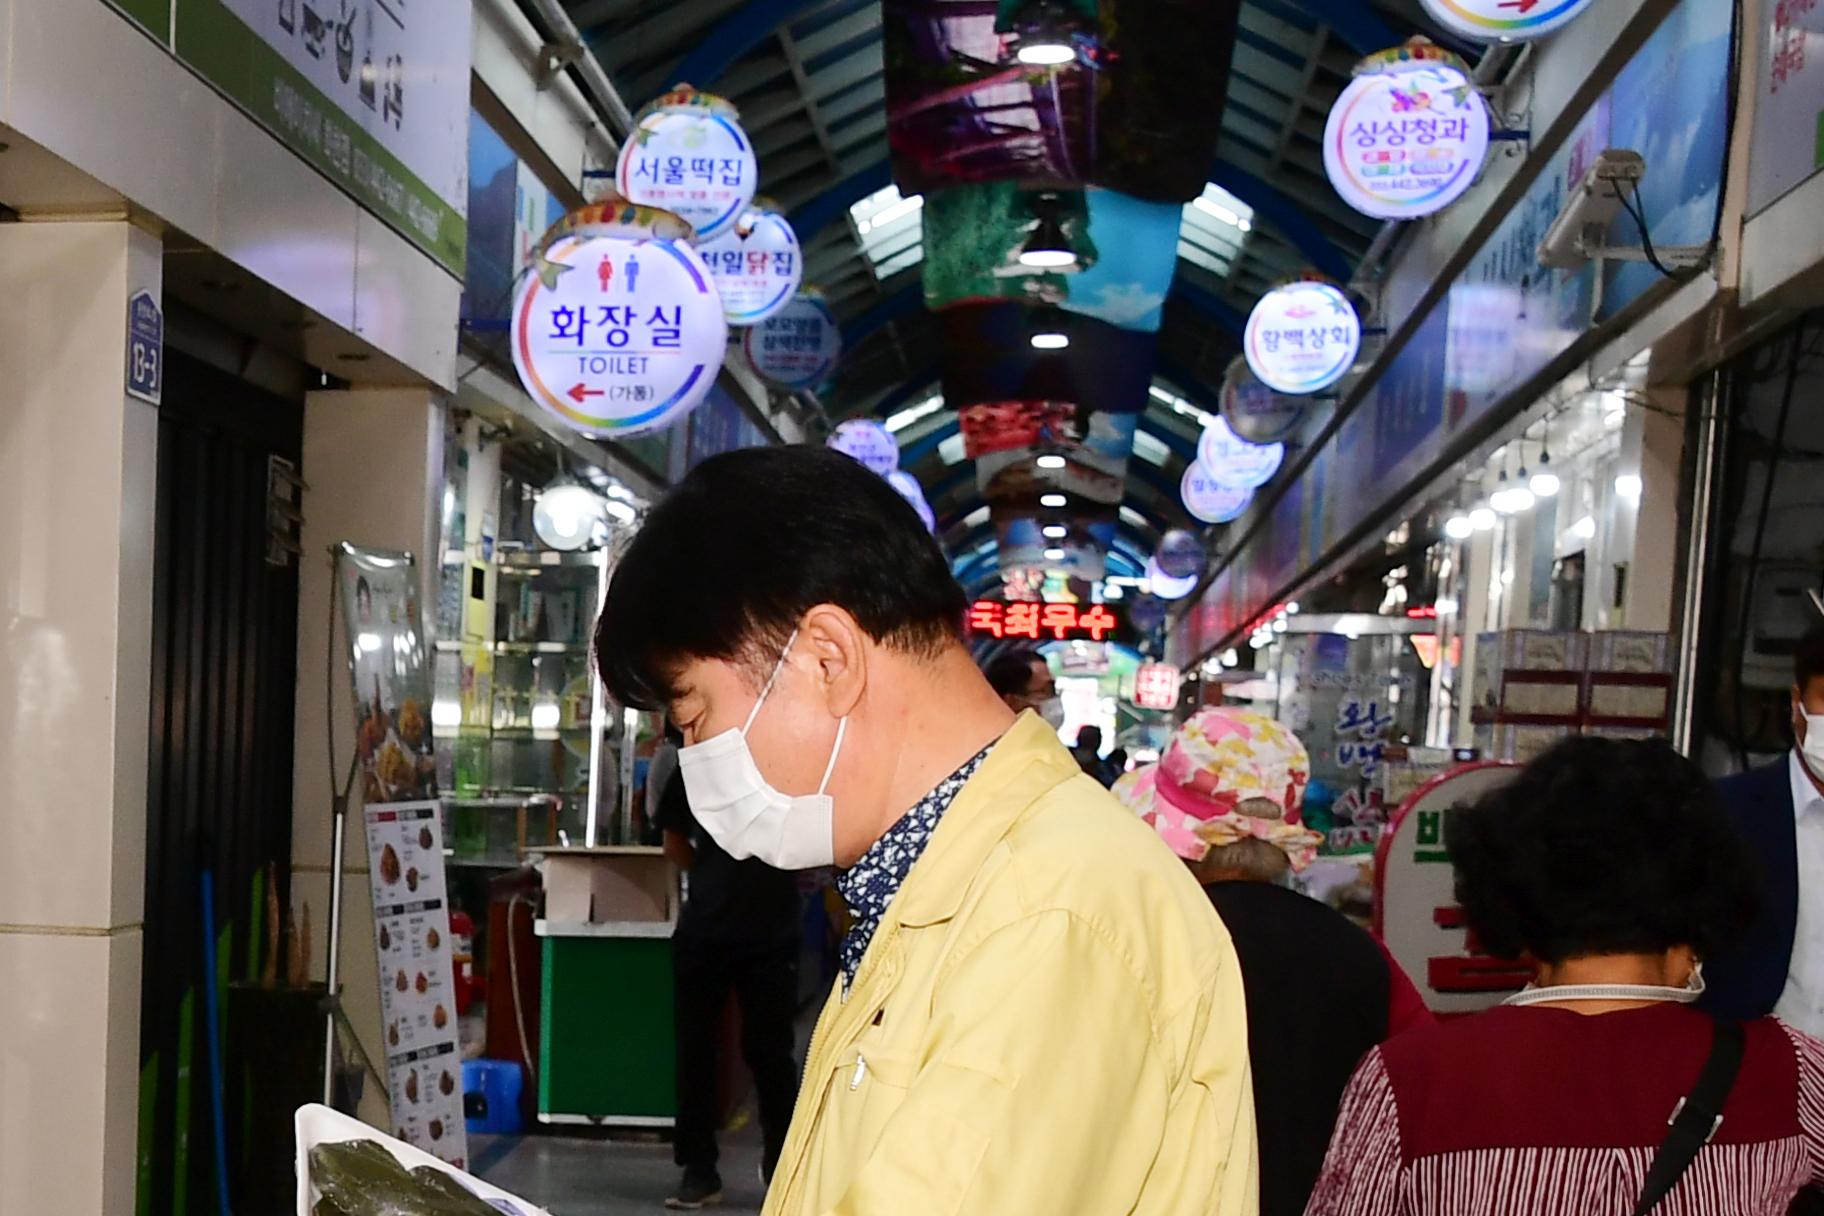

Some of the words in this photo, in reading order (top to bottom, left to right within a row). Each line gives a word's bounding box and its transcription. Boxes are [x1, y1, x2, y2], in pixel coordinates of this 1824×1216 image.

[1350, 117, 1469, 147] 싱싱청과
[635, 156, 743, 187] 서울떡집
[548, 304, 682, 348] 화장실
[133, 341, 157, 389] 13-3
[578, 356, 648, 375] TOILET
